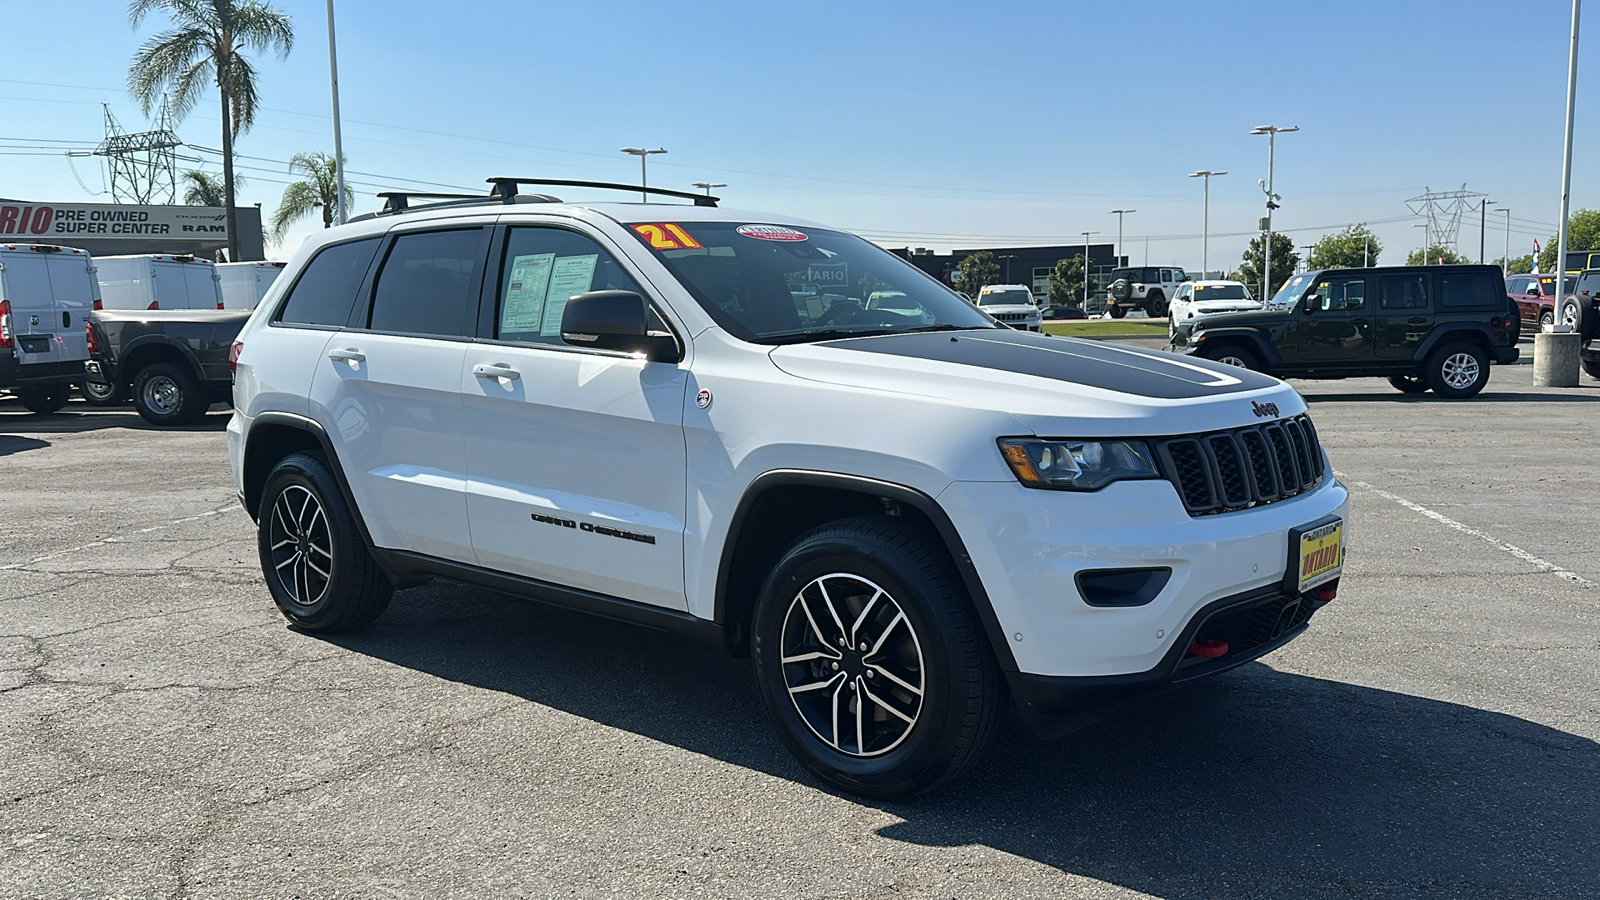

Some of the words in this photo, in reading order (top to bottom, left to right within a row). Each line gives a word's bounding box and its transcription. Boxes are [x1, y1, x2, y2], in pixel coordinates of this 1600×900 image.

[55, 210, 85, 221] PRE
[90, 211, 148, 222] OWNED
[55, 222, 107, 233] SUPER
[111, 223, 170, 234] CENTER
[634, 223, 700, 249] 21
[1251, 400, 1279, 418] Jeep
[531, 513, 576, 529] GRAND
[579, 522, 656, 545] CHEROKEE
[1302, 542, 1338, 577] ONTARIO
